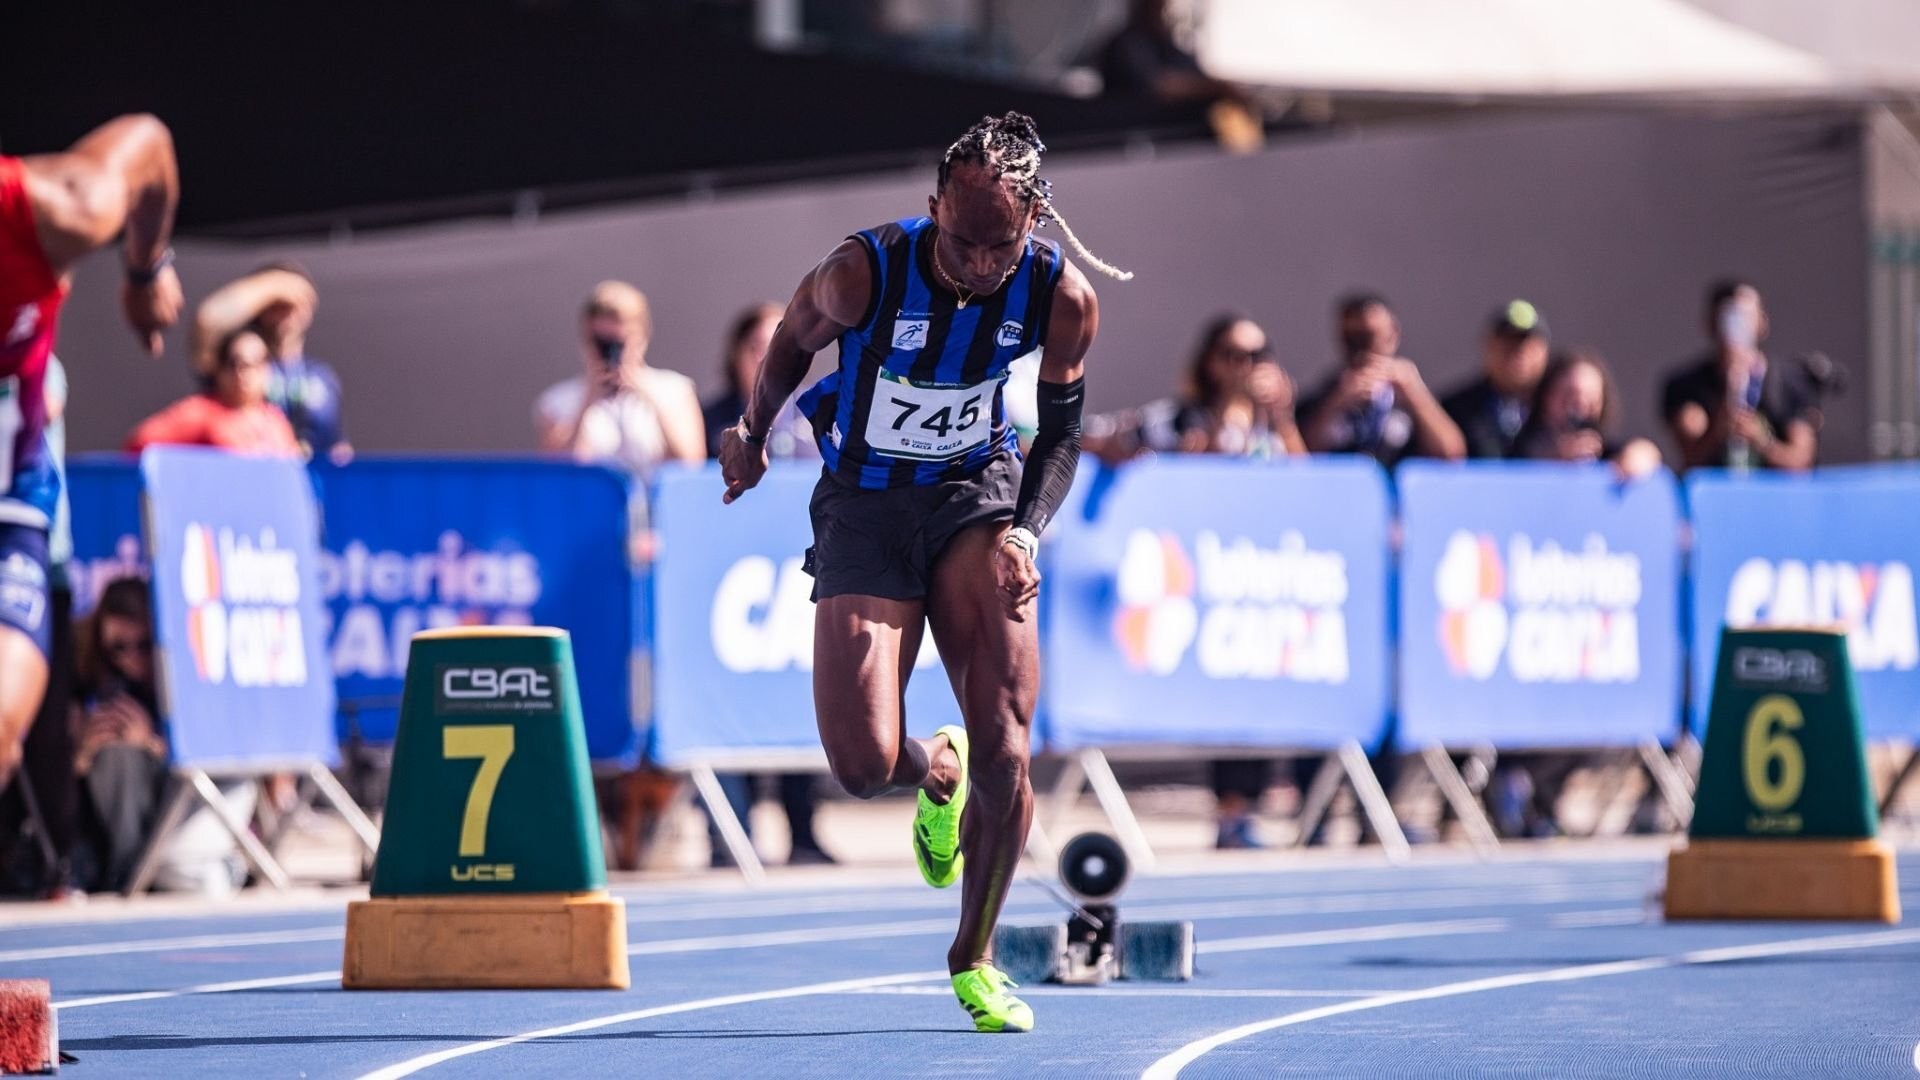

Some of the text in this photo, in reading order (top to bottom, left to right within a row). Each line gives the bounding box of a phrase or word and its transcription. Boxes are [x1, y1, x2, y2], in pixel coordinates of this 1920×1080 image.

[889, 394, 982, 437] 745
[937, 439, 963, 451] CAIXA
[314, 530, 542, 604] oterias
[1726, 557, 1918, 671] CAIXA
[1742, 694, 1806, 811] 6
[442, 724, 516, 857] 7
[450, 863, 515, 881] UCS
